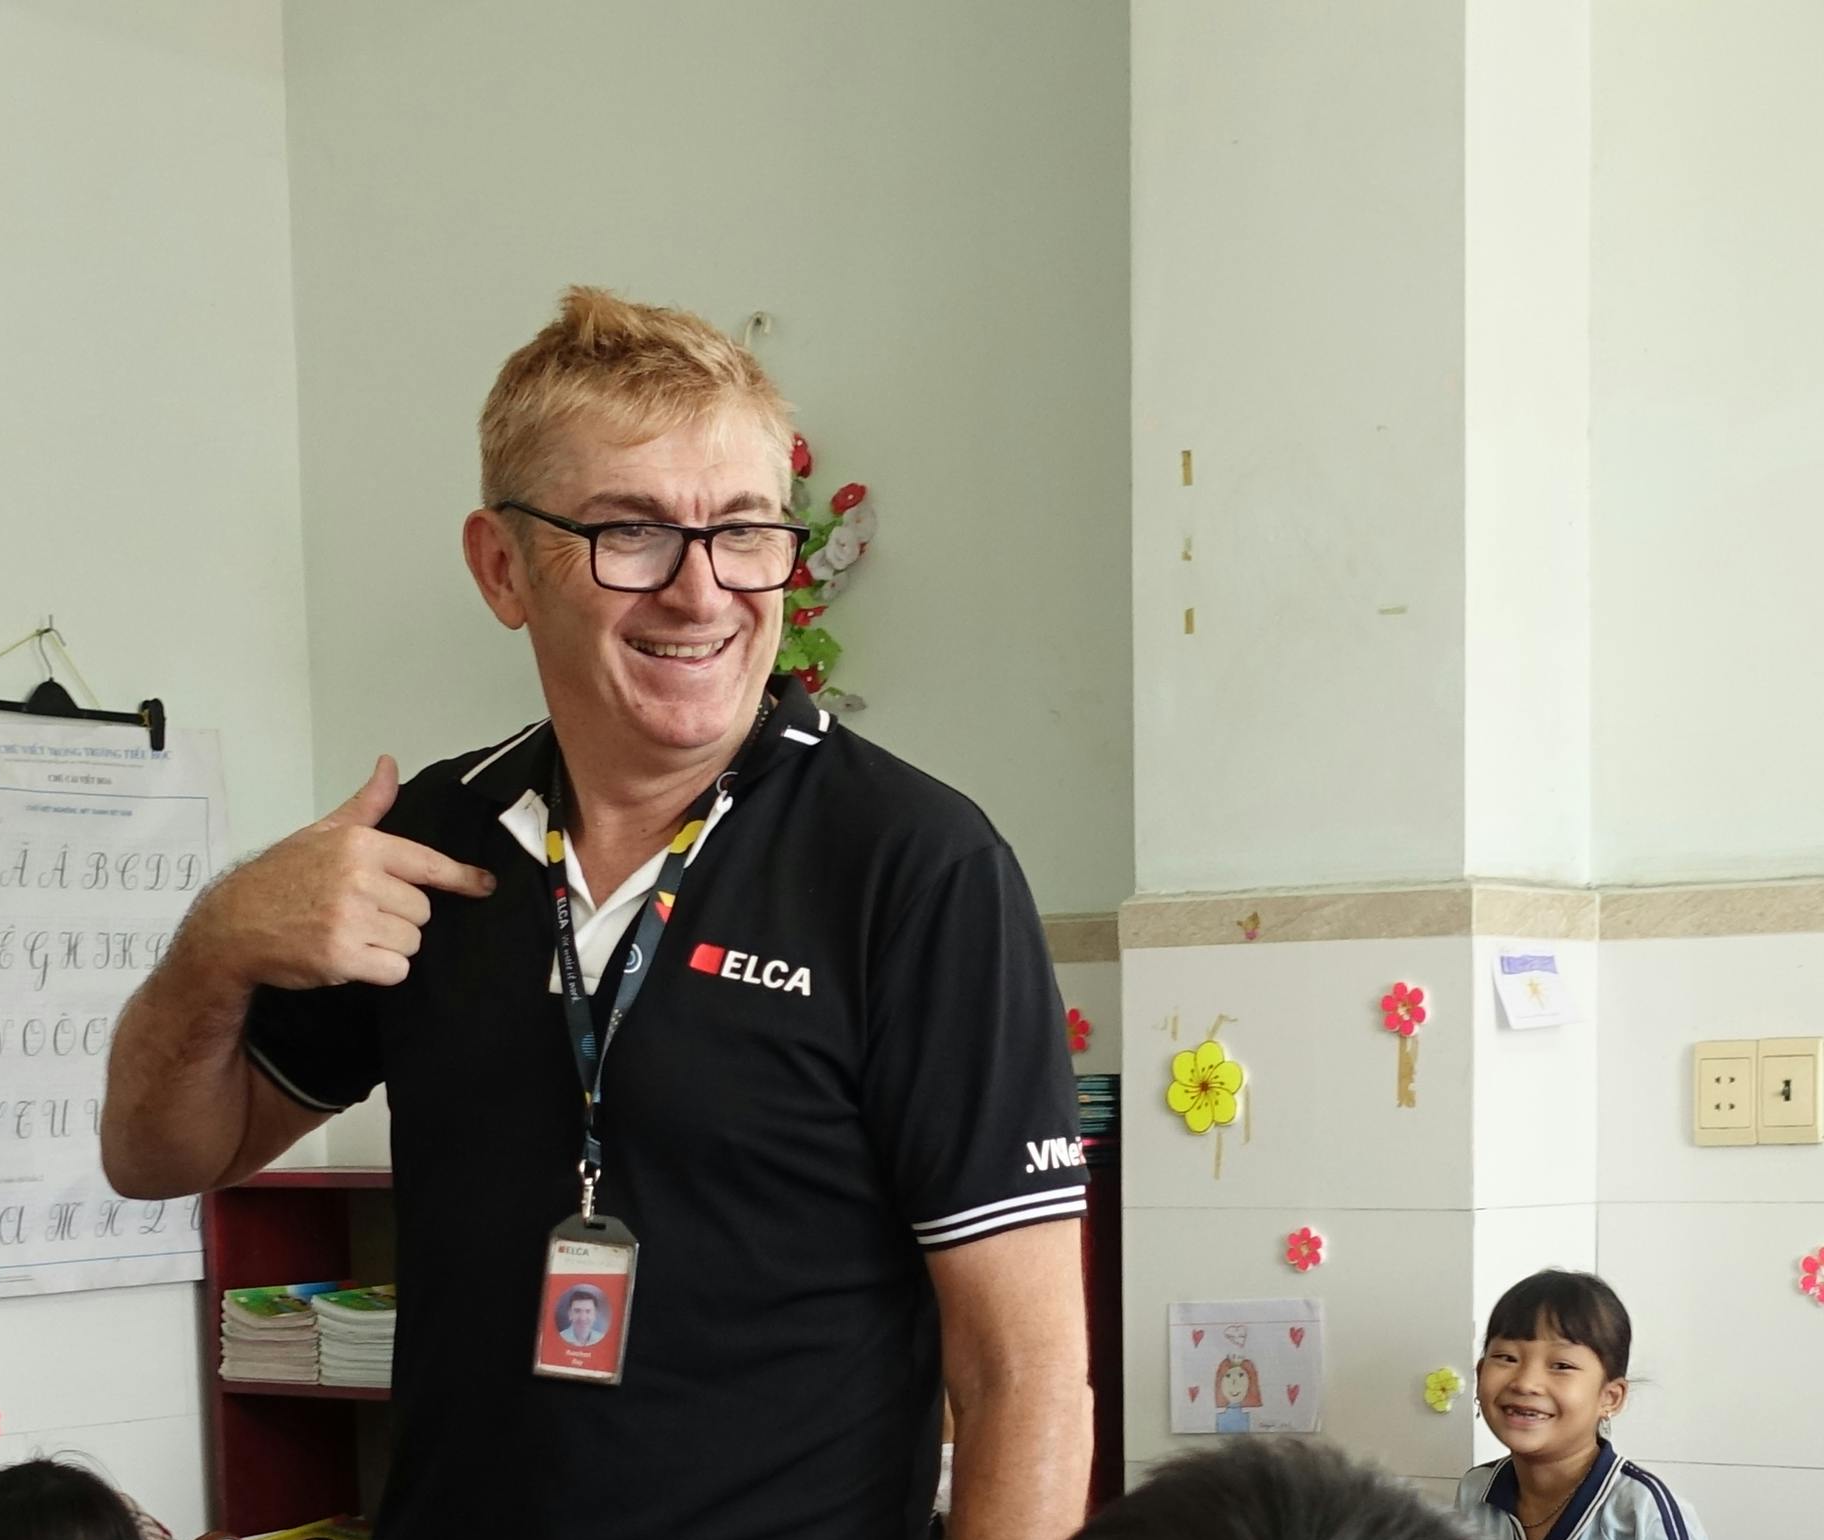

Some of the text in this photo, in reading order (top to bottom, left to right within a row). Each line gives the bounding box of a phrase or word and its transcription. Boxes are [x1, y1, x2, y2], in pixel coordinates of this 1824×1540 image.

[82, 851, 109, 890] B
[115, 852, 140, 891] C
[144, 853, 170, 891] D
[720, 949, 811, 997] ELCA
[22, 1018, 46, 1056] O
